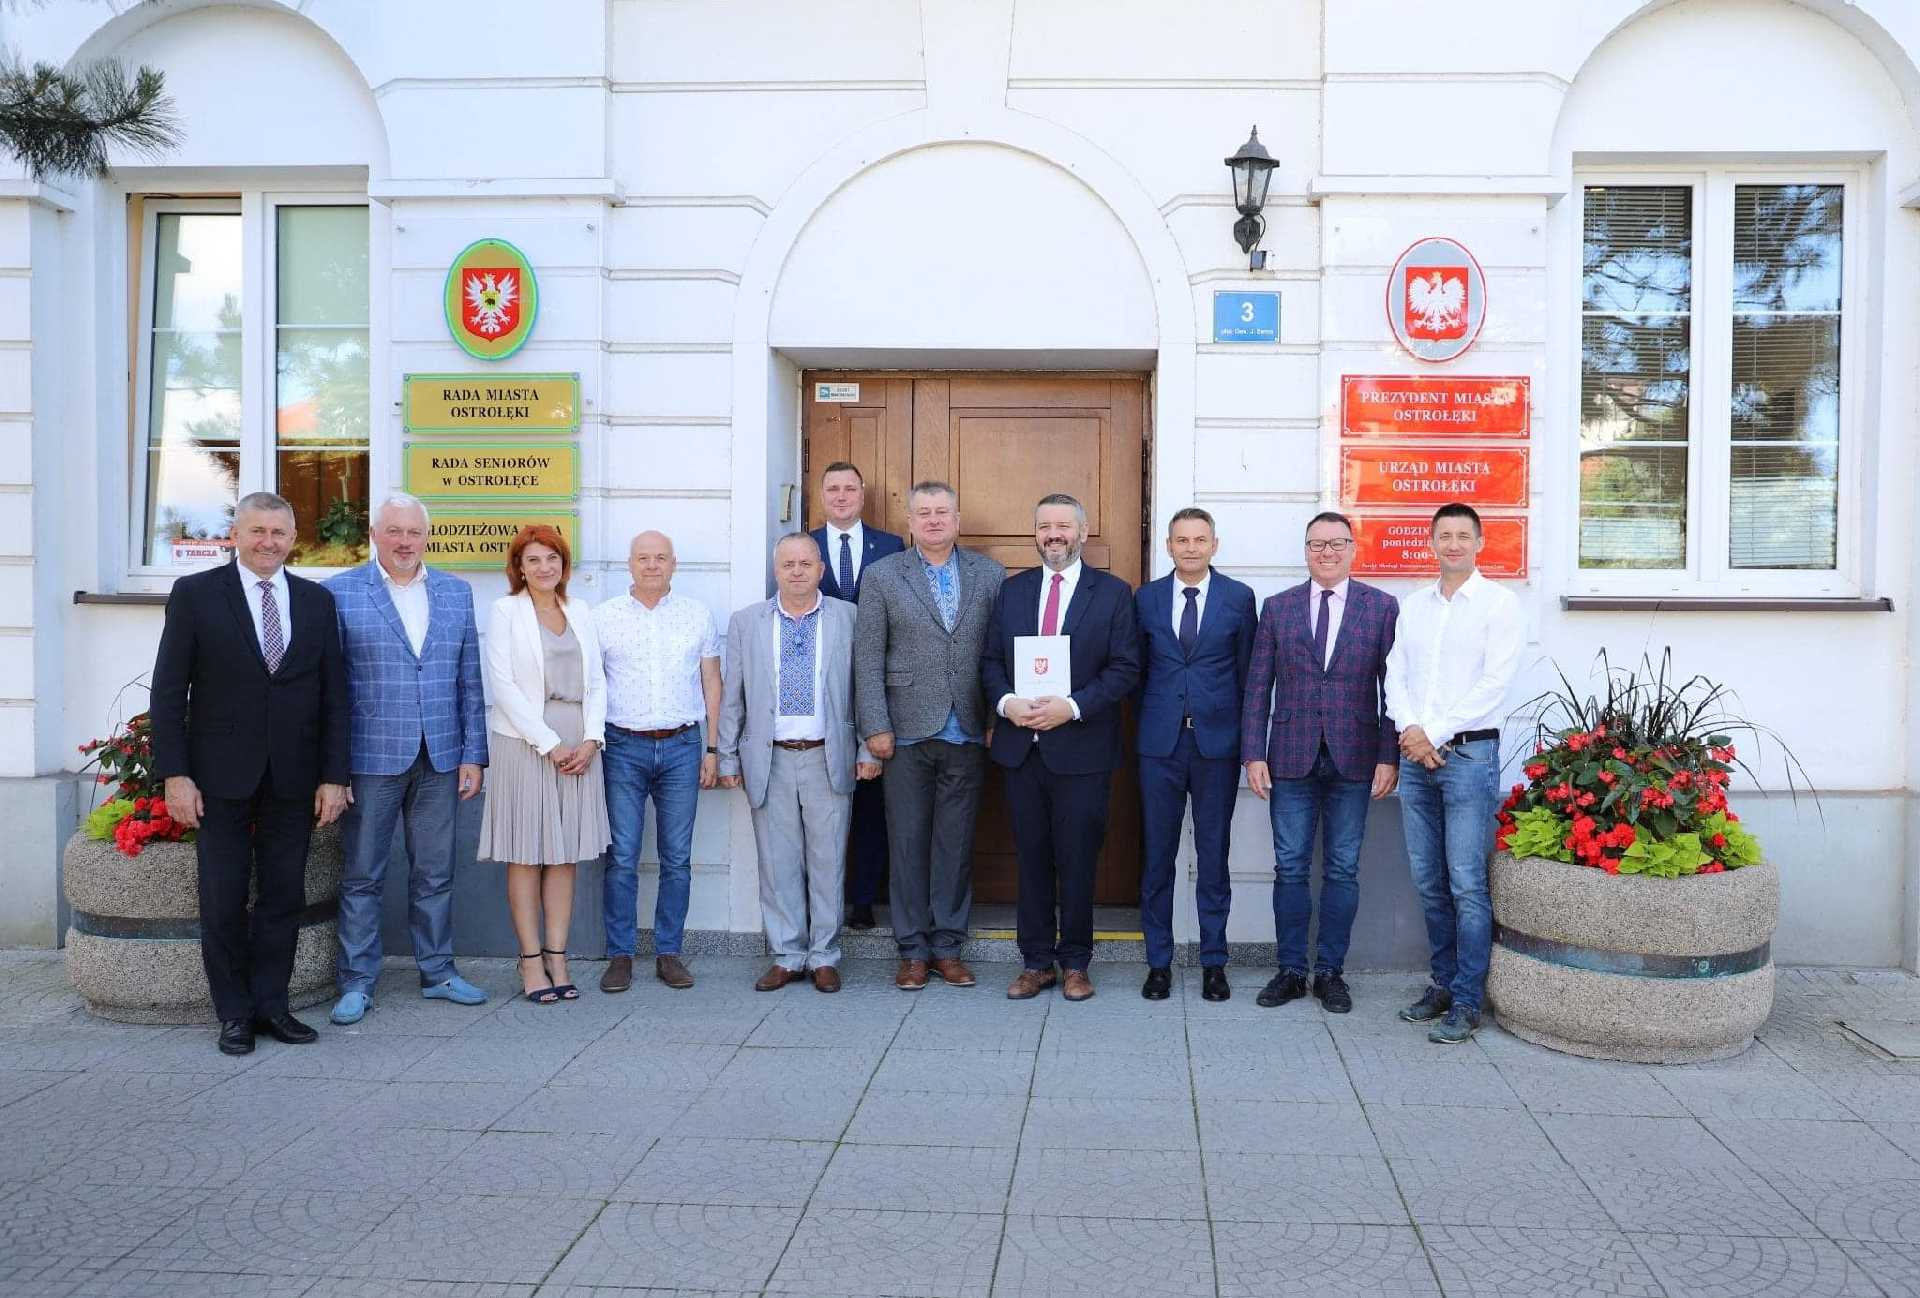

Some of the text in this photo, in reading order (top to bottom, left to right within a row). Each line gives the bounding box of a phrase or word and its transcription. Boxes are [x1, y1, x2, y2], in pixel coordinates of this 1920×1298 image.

[1241, 302, 1255, 322] 3
[443, 389, 539, 401] RADA MIASTA
[1361, 392, 1449, 404] PREZYDENT
[451, 407, 529, 420] OSTROŁĘKI
[1394, 410, 1476, 424] OSTROŁĘKI
[432, 455, 551, 469] RADA SENIORÓW
[1379, 462, 1490, 477] URZĄD MIASTA
[458, 475, 539, 488] OSTROŁĘCE
[1392, 480, 1476, 494] OSTROŁĘKI
[428, 522, 519, 536] ŁODZIEŻOWA
[1388, 526, 1432, 535] GODZIN
[425, 542, 475, 553] MIASTA
